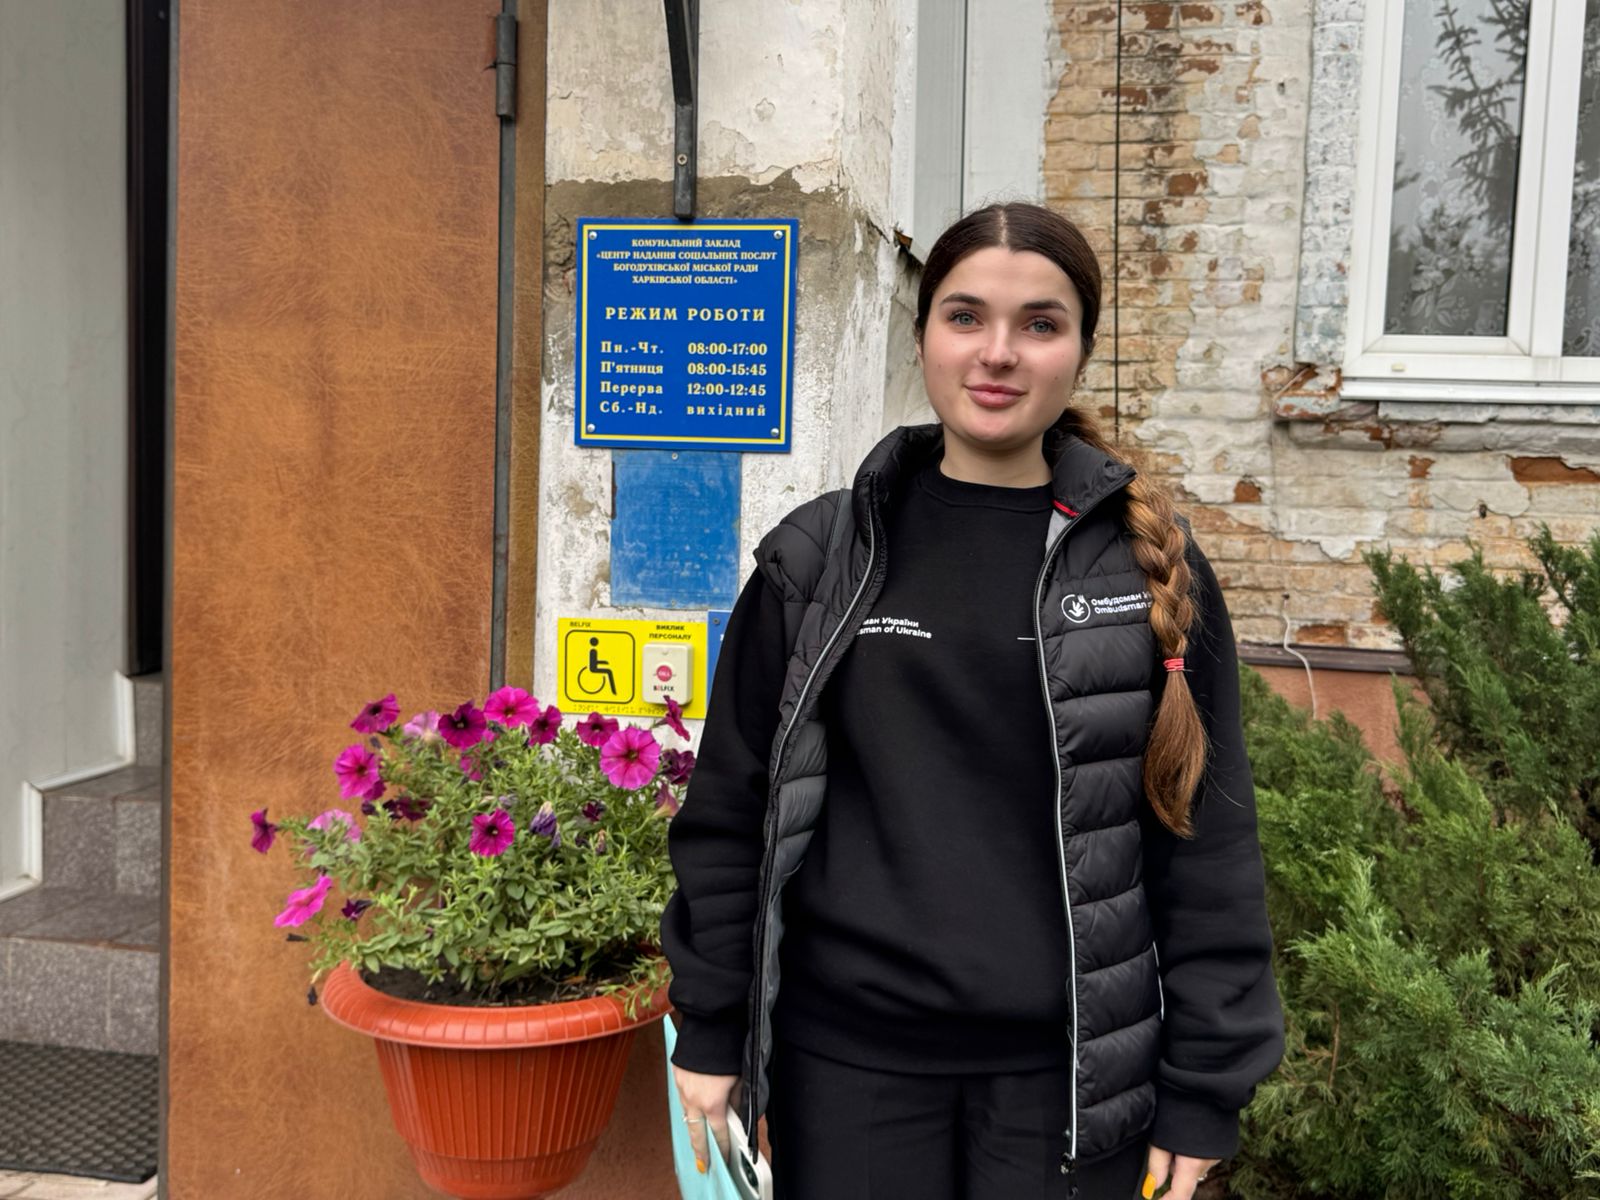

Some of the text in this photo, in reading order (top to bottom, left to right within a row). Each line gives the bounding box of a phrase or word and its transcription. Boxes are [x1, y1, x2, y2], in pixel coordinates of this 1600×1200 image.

[631, 238, 741, 248] КОМУНАЛЬНИЙ ЗАКЛАД
[632, 251, 676, 260] НАДАННЯ
[740, 252, 778, 260] ПОСЛУГ
[613, 262, 759, 272] БОГОДУХІВСЬКОЇ МІСЬКОЇ РАДИ
[631, 275, 692, 284] ХАРКІВСЬКОЇ
[605, 306, 765, 322] РЕЖИМ РОБОТИ
[600, 341, 767, 355] Пн.-Чт. 08:00-17:00
[600, 361, 767, 376] П'ятниця 08:00-15:45
[600, 381, 767, 397] Перерва 12:00-12:45
[599, 400, 766, 417] Сб.-Нд. вихідний
[1090, 594, 1142, 606] Омбудсман
[1094, 602, 1147, 614] Ombudsman
[881, 617, 919, 628] України
[884, 625, 895, 633] of
[896, 626, 932, 639] Ukraine
